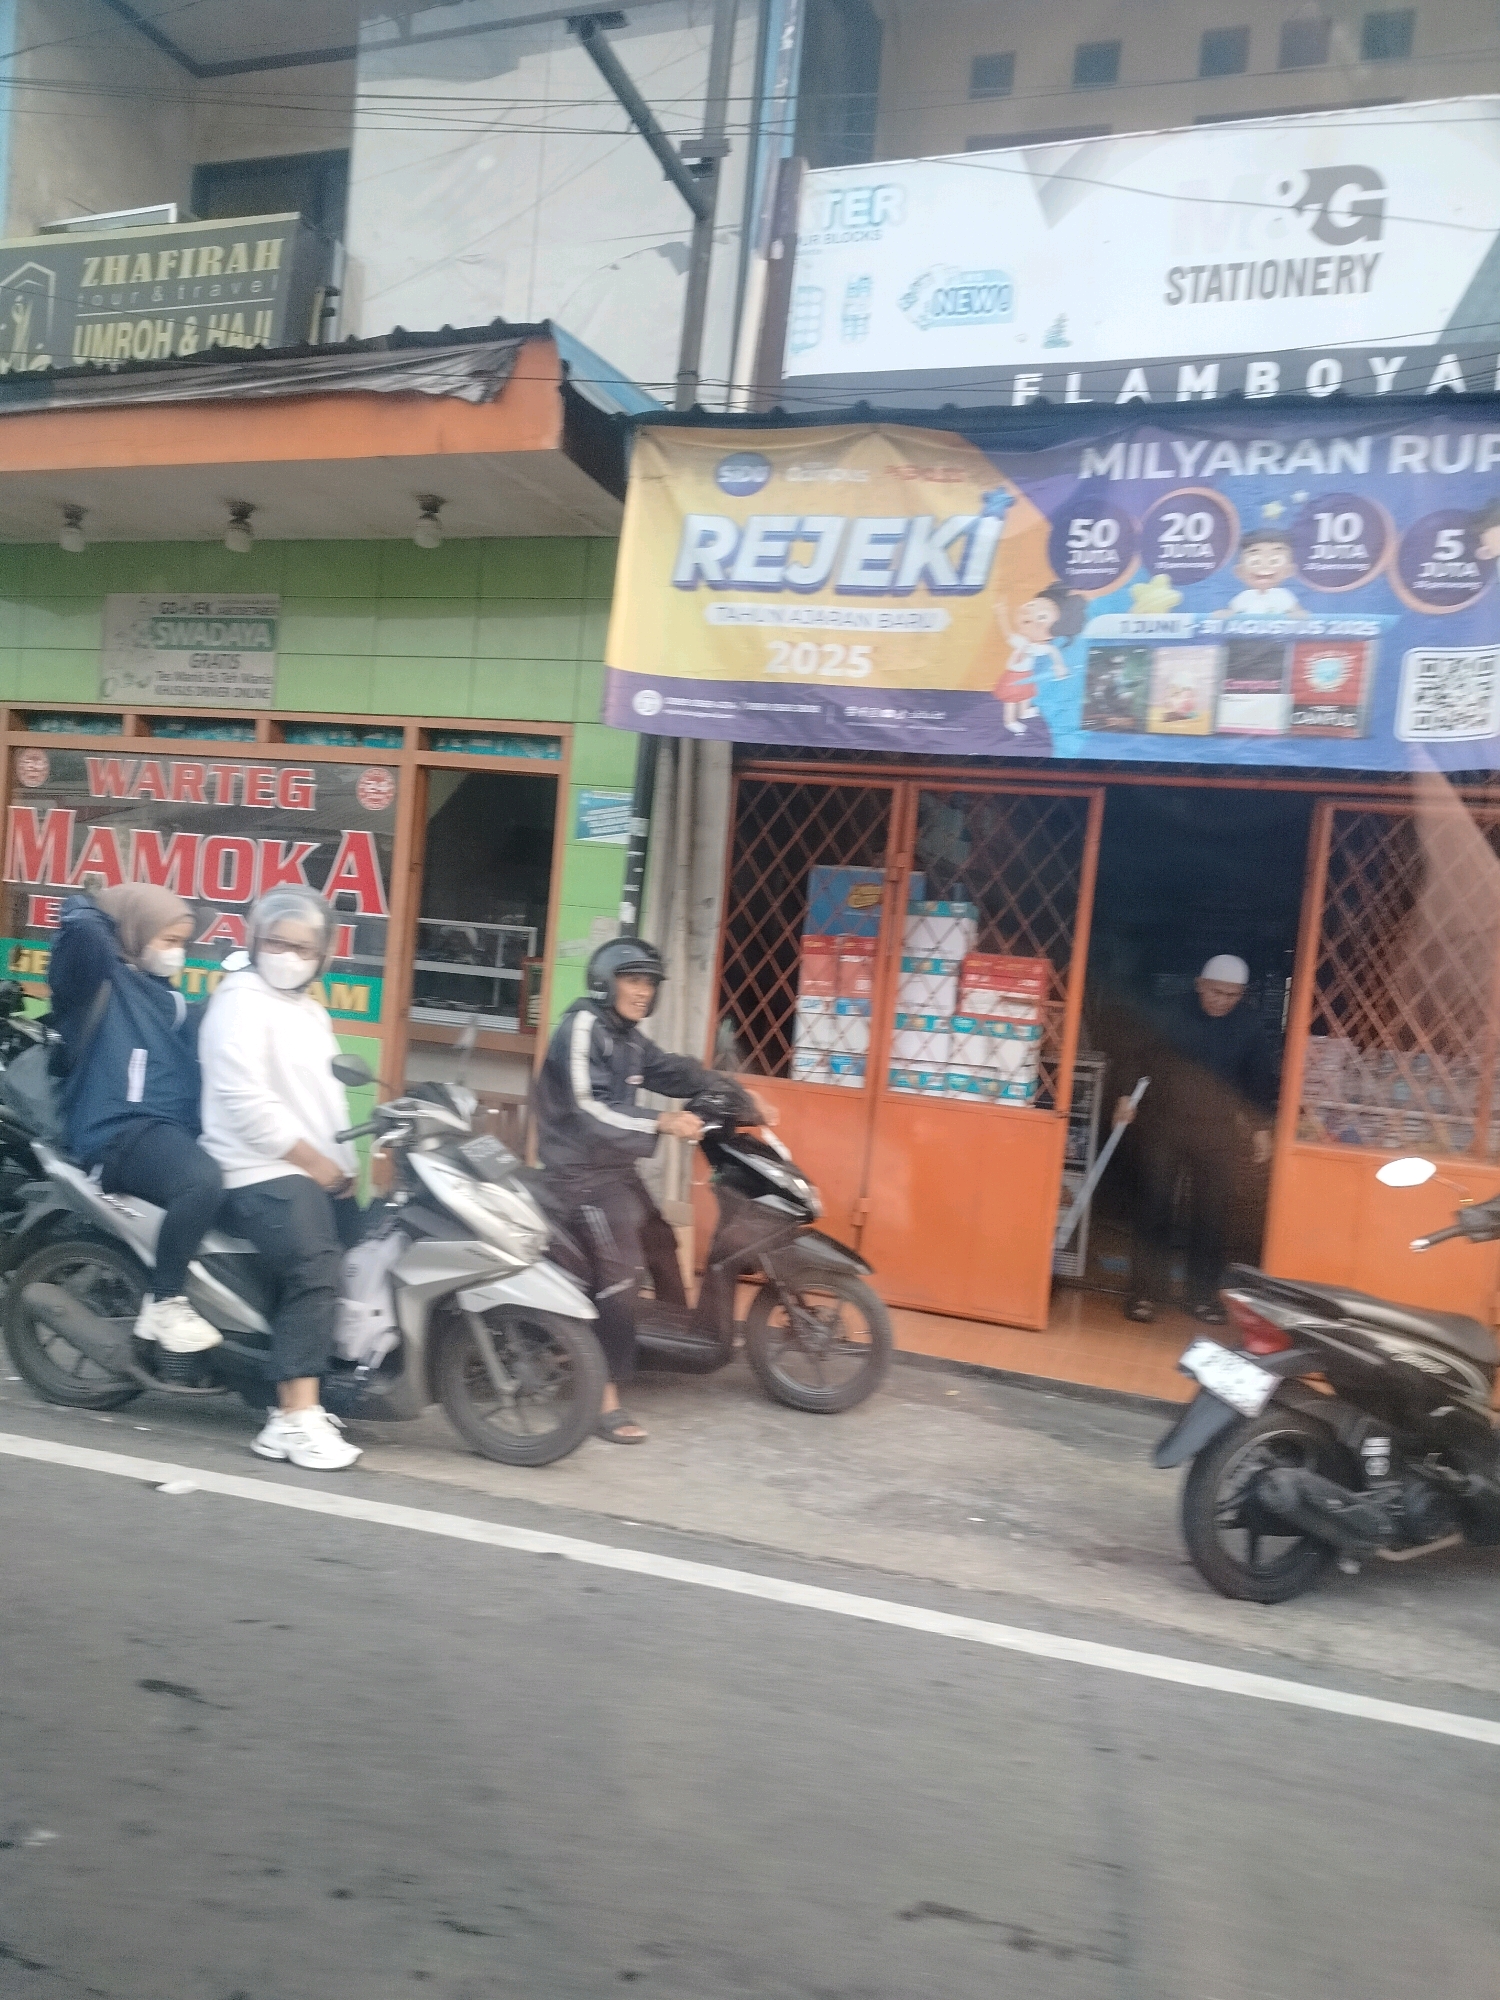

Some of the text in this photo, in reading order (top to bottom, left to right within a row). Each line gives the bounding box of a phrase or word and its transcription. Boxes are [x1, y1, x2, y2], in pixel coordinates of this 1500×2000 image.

[80, 238, 285, 287] ZHAFIRAH
[1163, 252, 1384, 306] STATIONERY
[176, 274, 279, 300] travel
[71, 318, 176, 364] UMROH
[179, 316, 200, 357] &
[1010, 354, 1500, 407] FLAMBOYA
[1078, 436, 1372, 480] MILYARAN
[1066, 519, 1121, 549] 50
[1157, 512, 1215, 542] 20
[1313, 512, 1364, 543] 10
[1432, 529, 1466, 561] 5
[671, 512, 1006, 597] REJEKI
[154, 621, 271, 648] SWADAYA
[877, 611, 934, 629] BARU
[765, 639, 874, 678] 2025
[85, 757, 317, 811] WARTEG
[2, 806, 391, 918] MAMOKA
